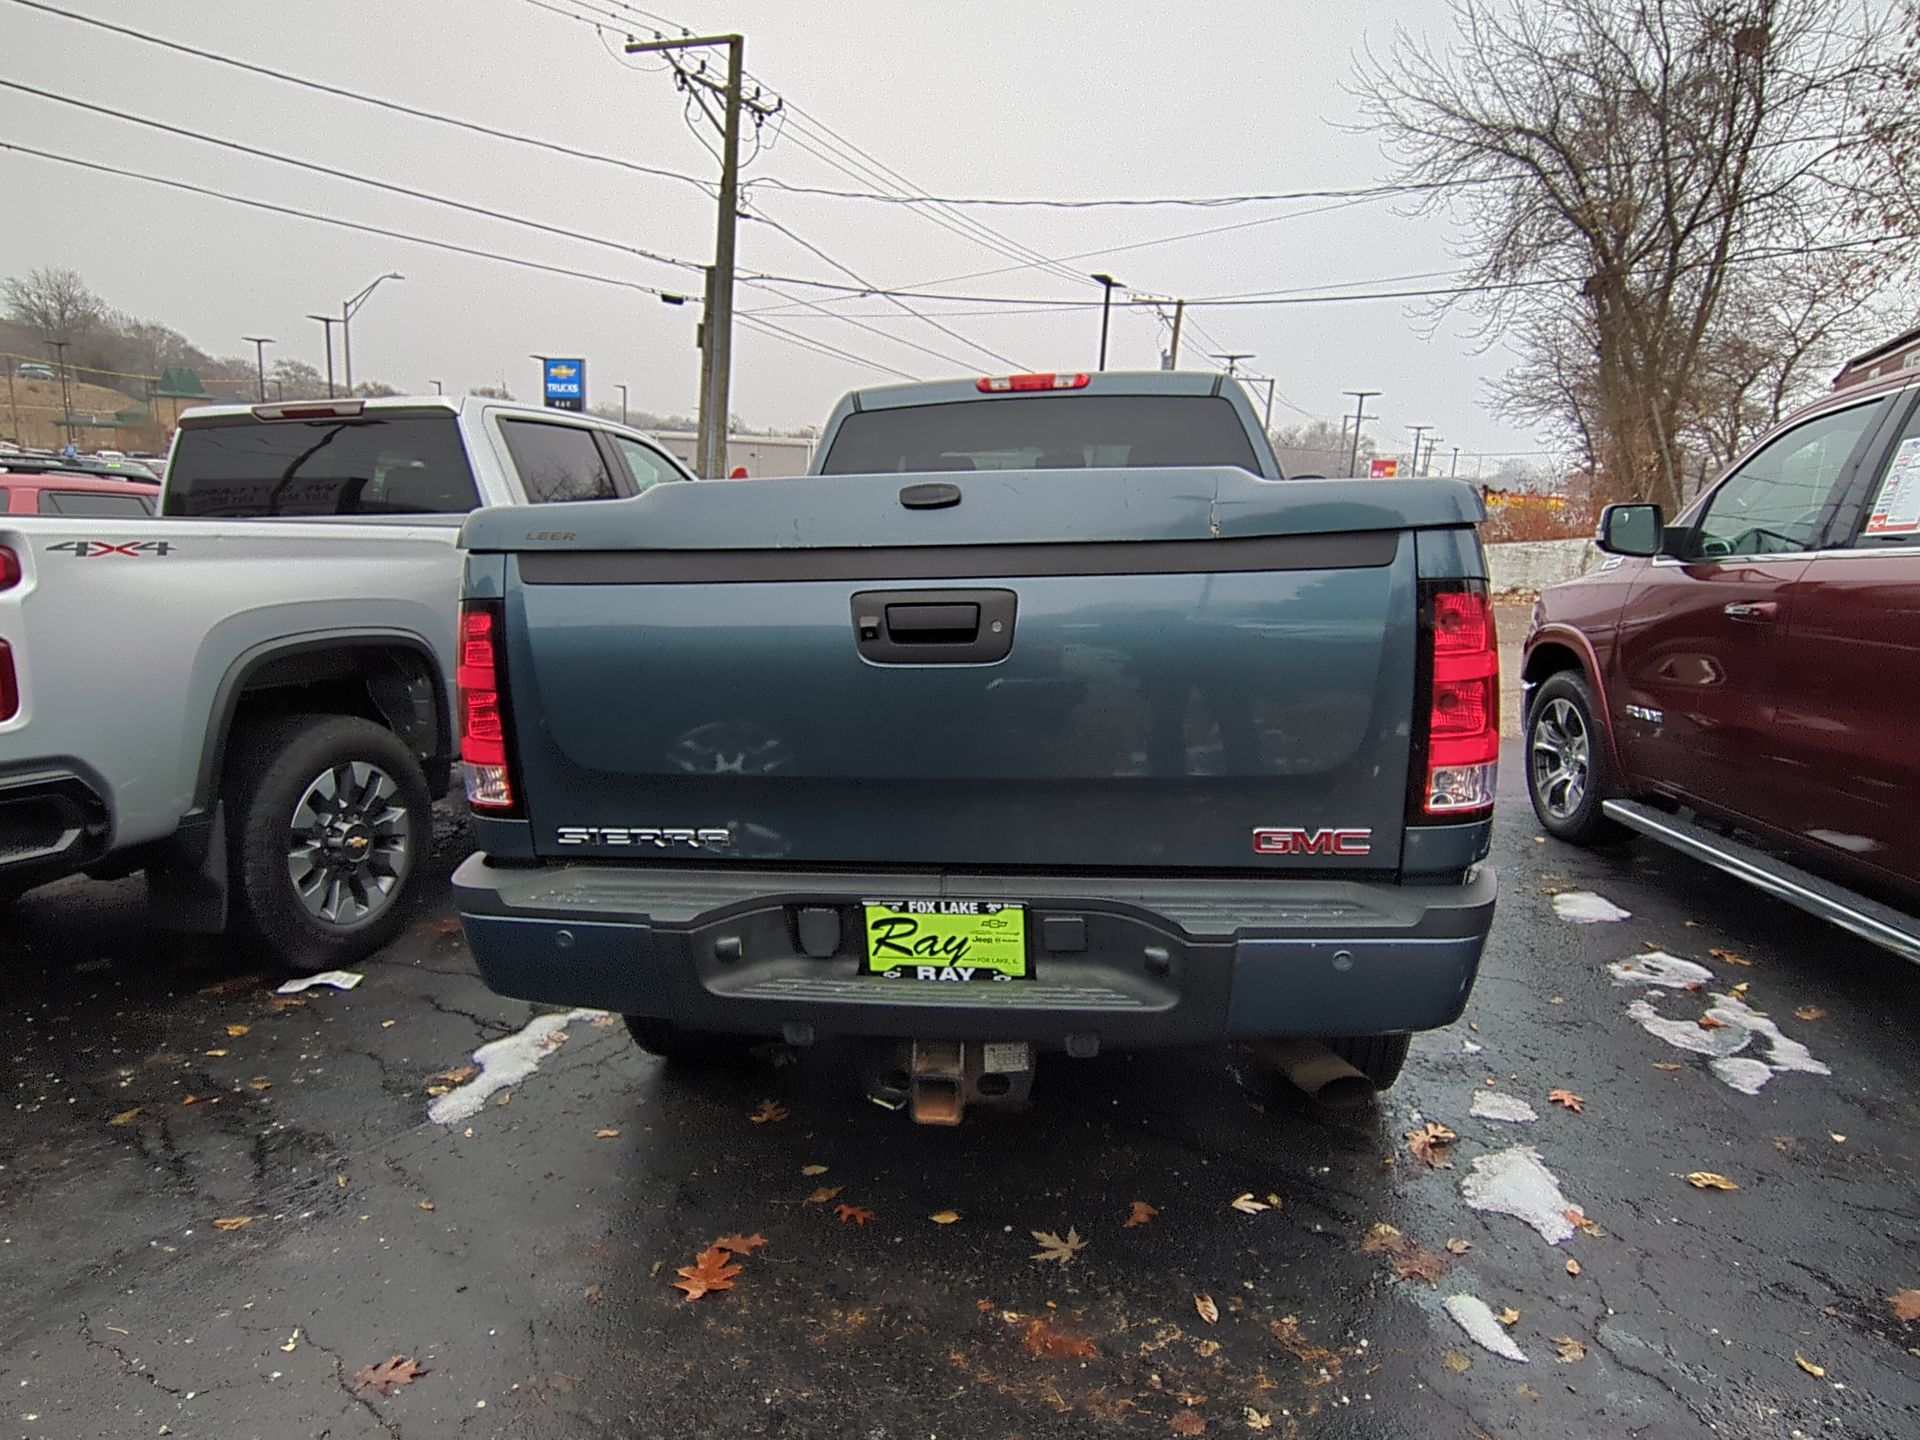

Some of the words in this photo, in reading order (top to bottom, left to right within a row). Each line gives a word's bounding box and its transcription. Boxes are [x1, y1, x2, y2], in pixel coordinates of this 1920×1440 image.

[547, 383, 579, 393] TRUCKS
[525, 531, 577, 541] LEER
[557, 827, 731, 848] SIERRA
[1252, 828, 1372, 855] GMC
[908, 902, 937, 914] FOX
[940, 902, 979, 915] LAKE
[870, 917, 972, 967] Ray
[972, 935, 993, 944] Jeep
[917, 966, 976, 982] RAY
